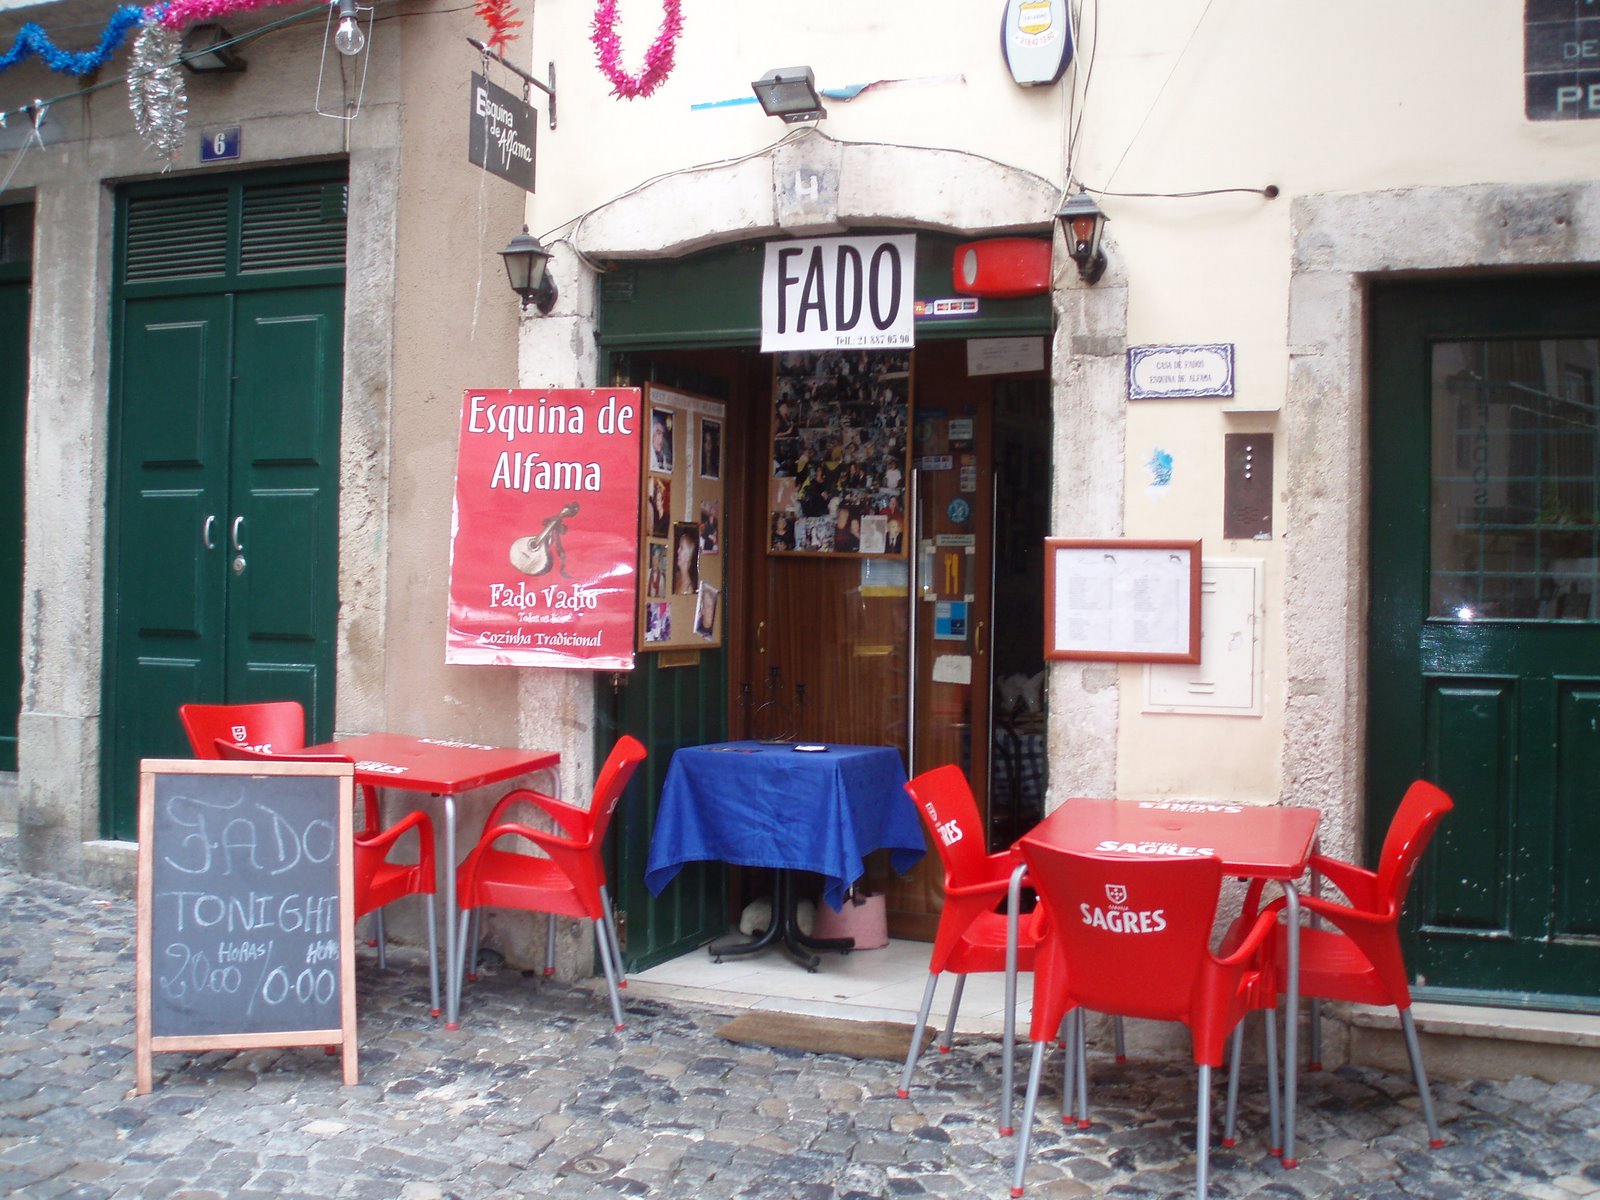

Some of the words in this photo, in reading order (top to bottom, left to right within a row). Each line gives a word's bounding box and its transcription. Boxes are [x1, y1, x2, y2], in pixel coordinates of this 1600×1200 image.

[1563, 39, 1599, 60] DE
[476, 87, 514, 128] Esquina
[213, 132, 227, 156] 6
[490, 121, 501, 138] de
[497, 127, 533, 171] Alfama
[777, 242, 901, 335] FADO
[857, 335, 868, 345] 21
[899, 333, 910, 344] 90
[467, 394, 584, 442] Esquina
[597, 395, 633, 436] de
[489, 451, 602, 493] Alfama
[489, 581, 536, 609] Fado
[540, 583, 599, 611] Vadio
[479, 627, 531, 646] Cozinha
[534, 630, 602, 647] Tradicional
[164, 786, 337, 876] FADO
[1095, 840, 1215, 857] SAGRES
[156, 891, 339, 935] TONIGHT
[1079, 902, 1167, 934] SAGRES
